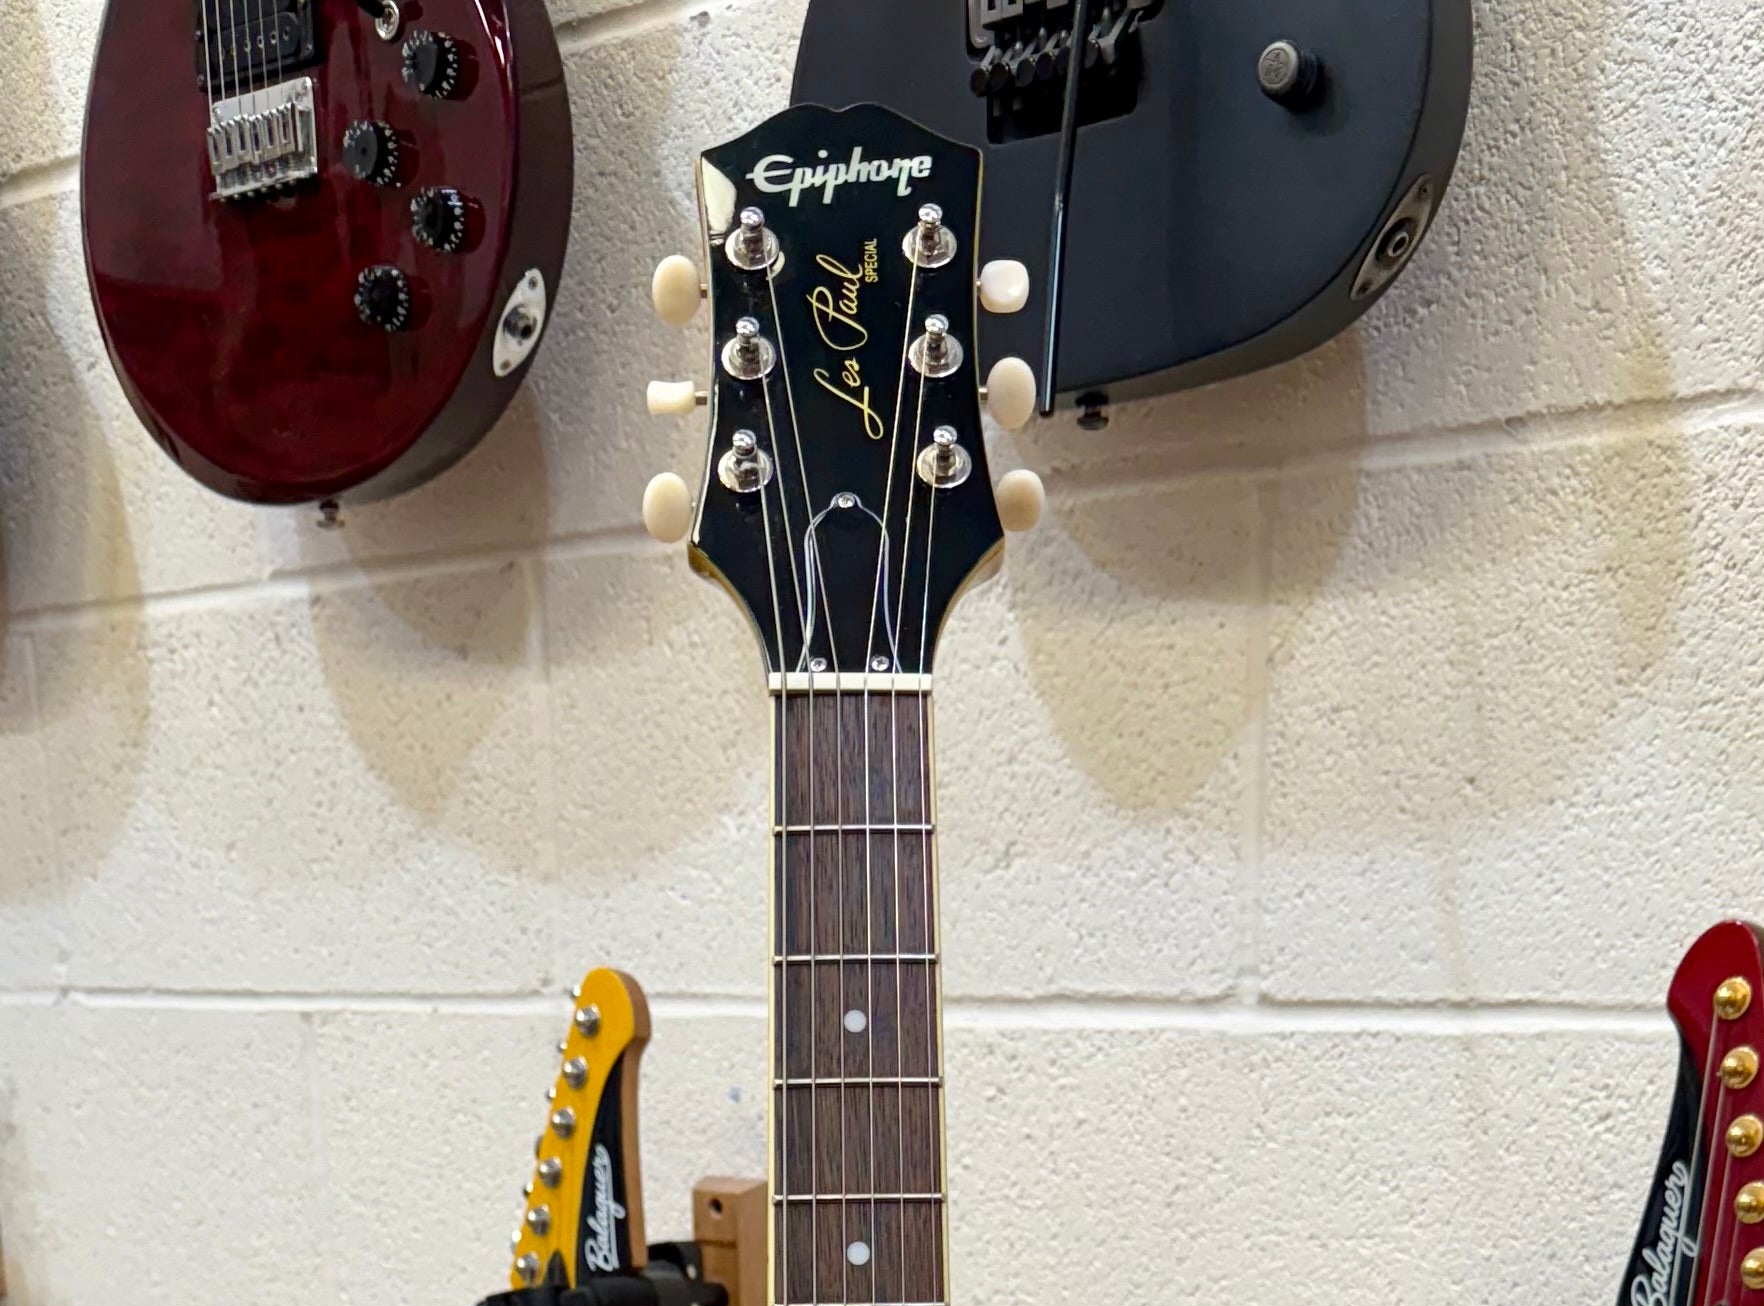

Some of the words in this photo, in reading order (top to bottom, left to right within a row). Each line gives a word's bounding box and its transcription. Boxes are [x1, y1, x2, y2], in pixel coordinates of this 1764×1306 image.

[745, 146, 933, 207] Epiphone
[864, 238, 877, 283] SPECIAL
[806, 254, 868, 351] Paul
[813, 357, 884, 440] Les
[585, 1143, 626, 1272] Balaguer
